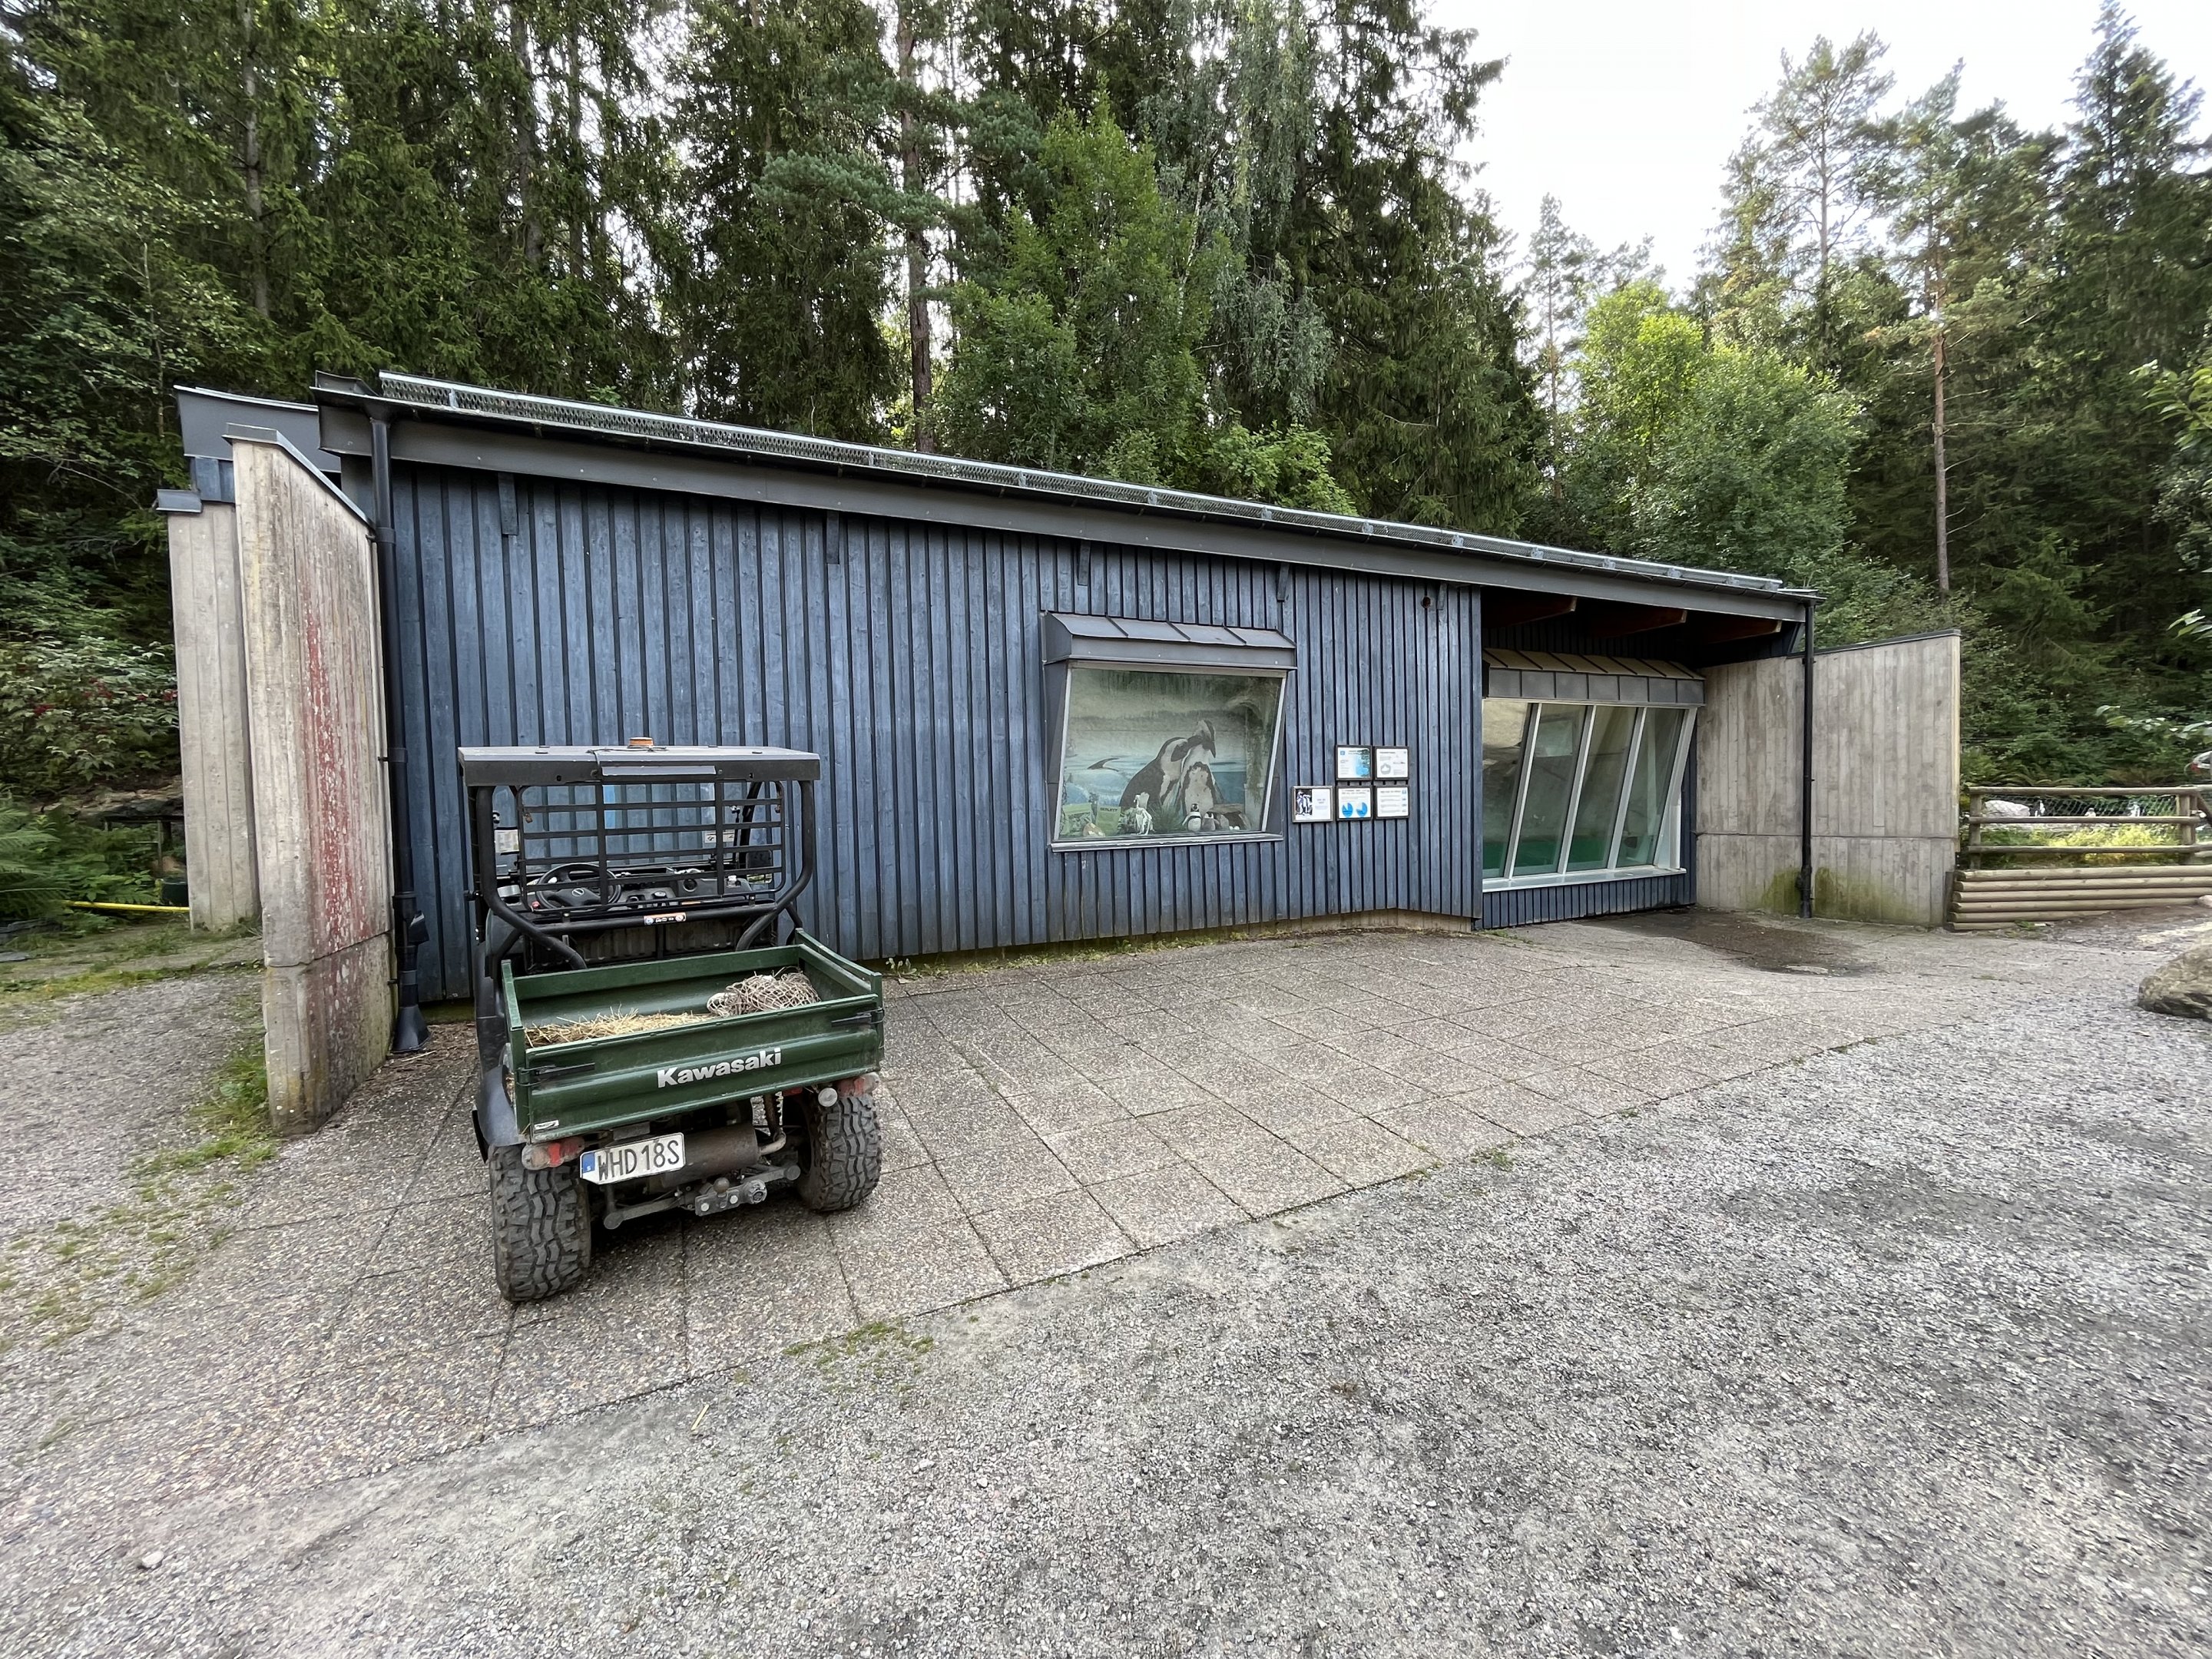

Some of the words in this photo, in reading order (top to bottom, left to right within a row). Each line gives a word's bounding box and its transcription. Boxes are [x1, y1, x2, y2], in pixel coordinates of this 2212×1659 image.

[657, 1047, 781, 1088] Kawasaki
[598, 1147, 637, 1181] WHD
[641, 1140, 680, 1171] 18S
